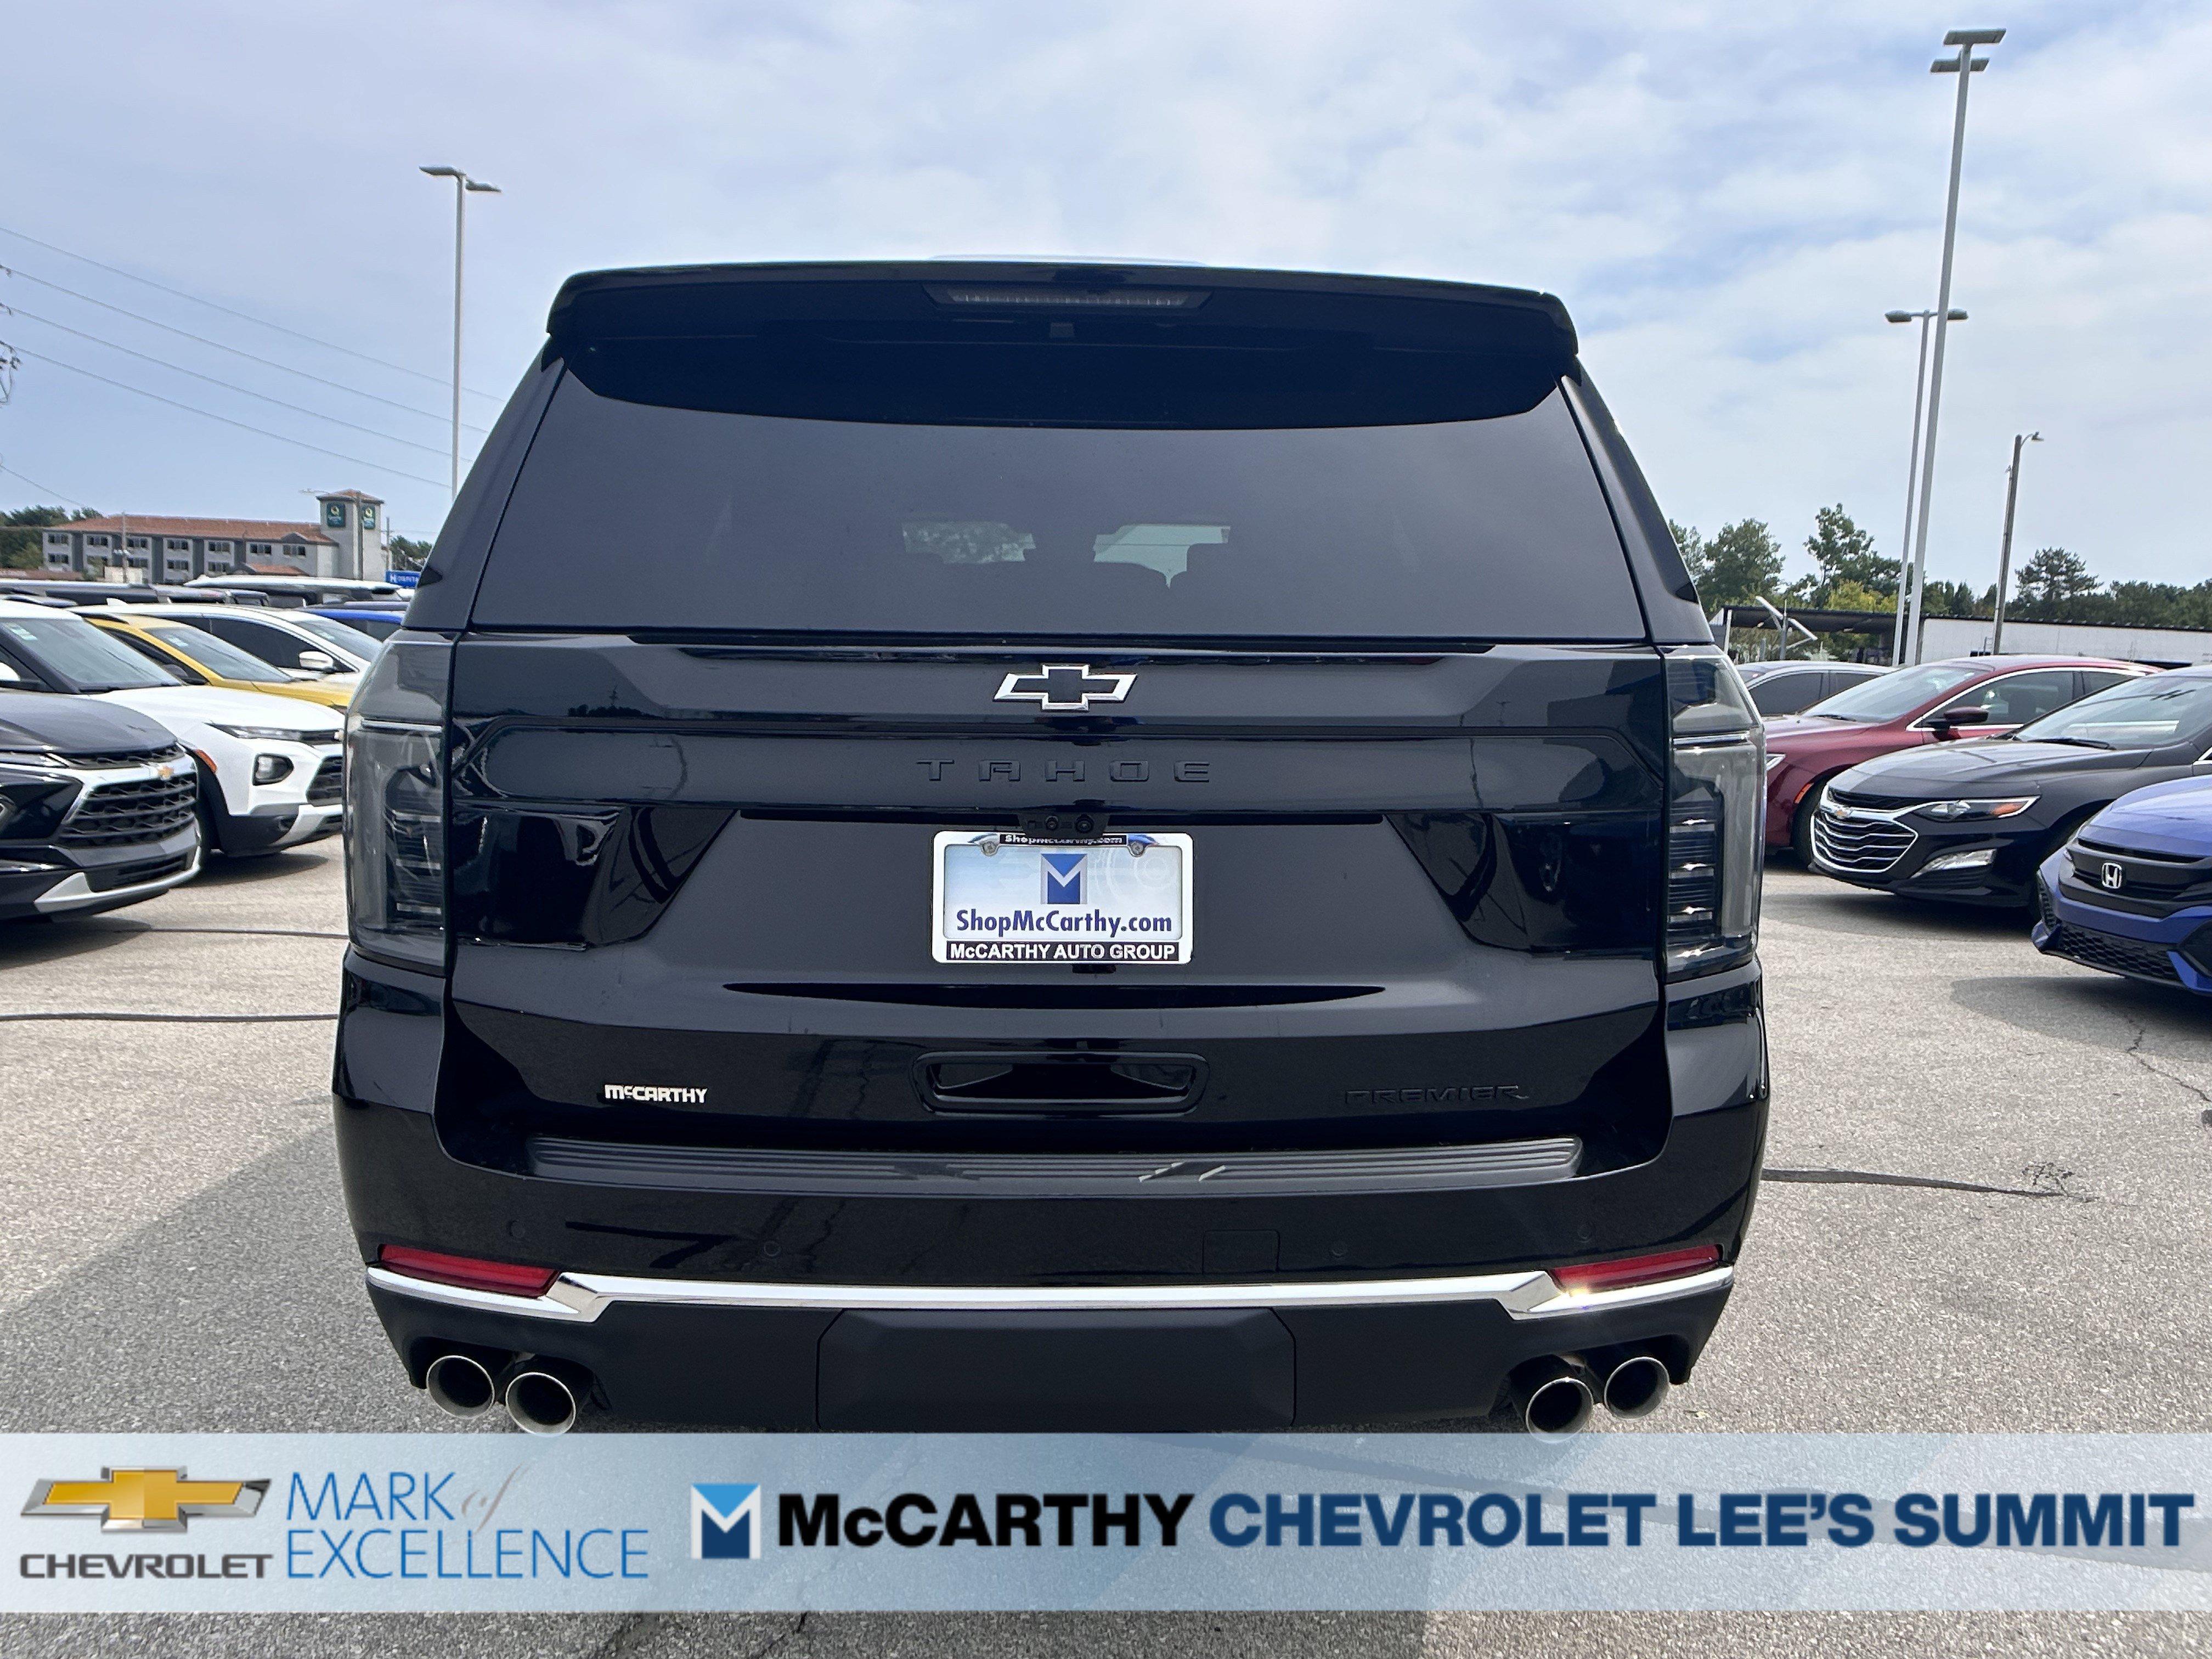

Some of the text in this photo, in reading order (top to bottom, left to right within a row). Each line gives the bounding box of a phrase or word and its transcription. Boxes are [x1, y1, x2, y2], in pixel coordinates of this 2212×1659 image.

[917, 759, 1210, 782] TAHOE
[956, 909, 1172, 938] ShopMcCarthy.com
[950, 943, 1176, 960] McCARTHY AUTO GROUP
[604, 1084, 708, 1103] McCARTHY
[1345, 1085, 1530, 1104] PREMIER
